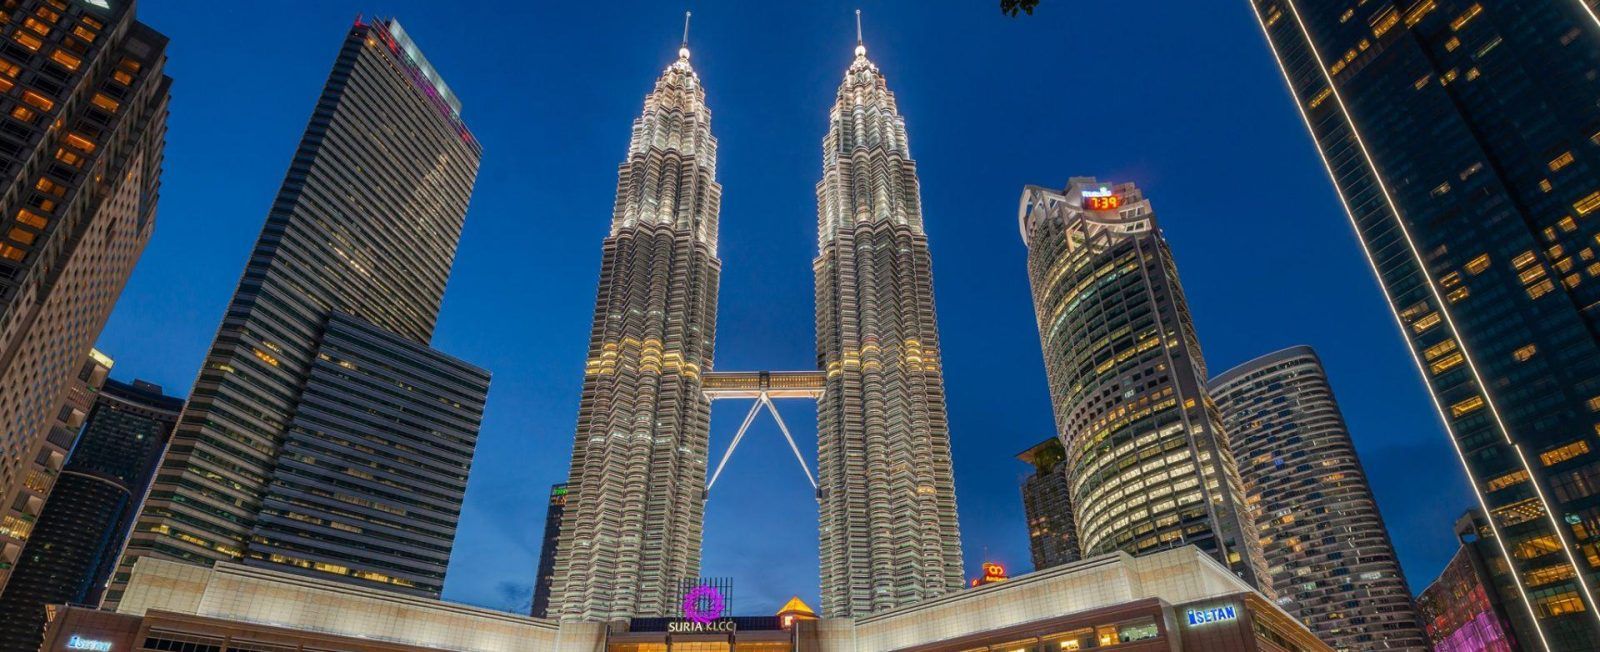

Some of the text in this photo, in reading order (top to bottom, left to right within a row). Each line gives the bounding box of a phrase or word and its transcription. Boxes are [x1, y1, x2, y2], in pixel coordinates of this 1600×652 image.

[1092, 197, 1117, 209] 7:39
[668, 621, 734, 632] SURIA KLCC
